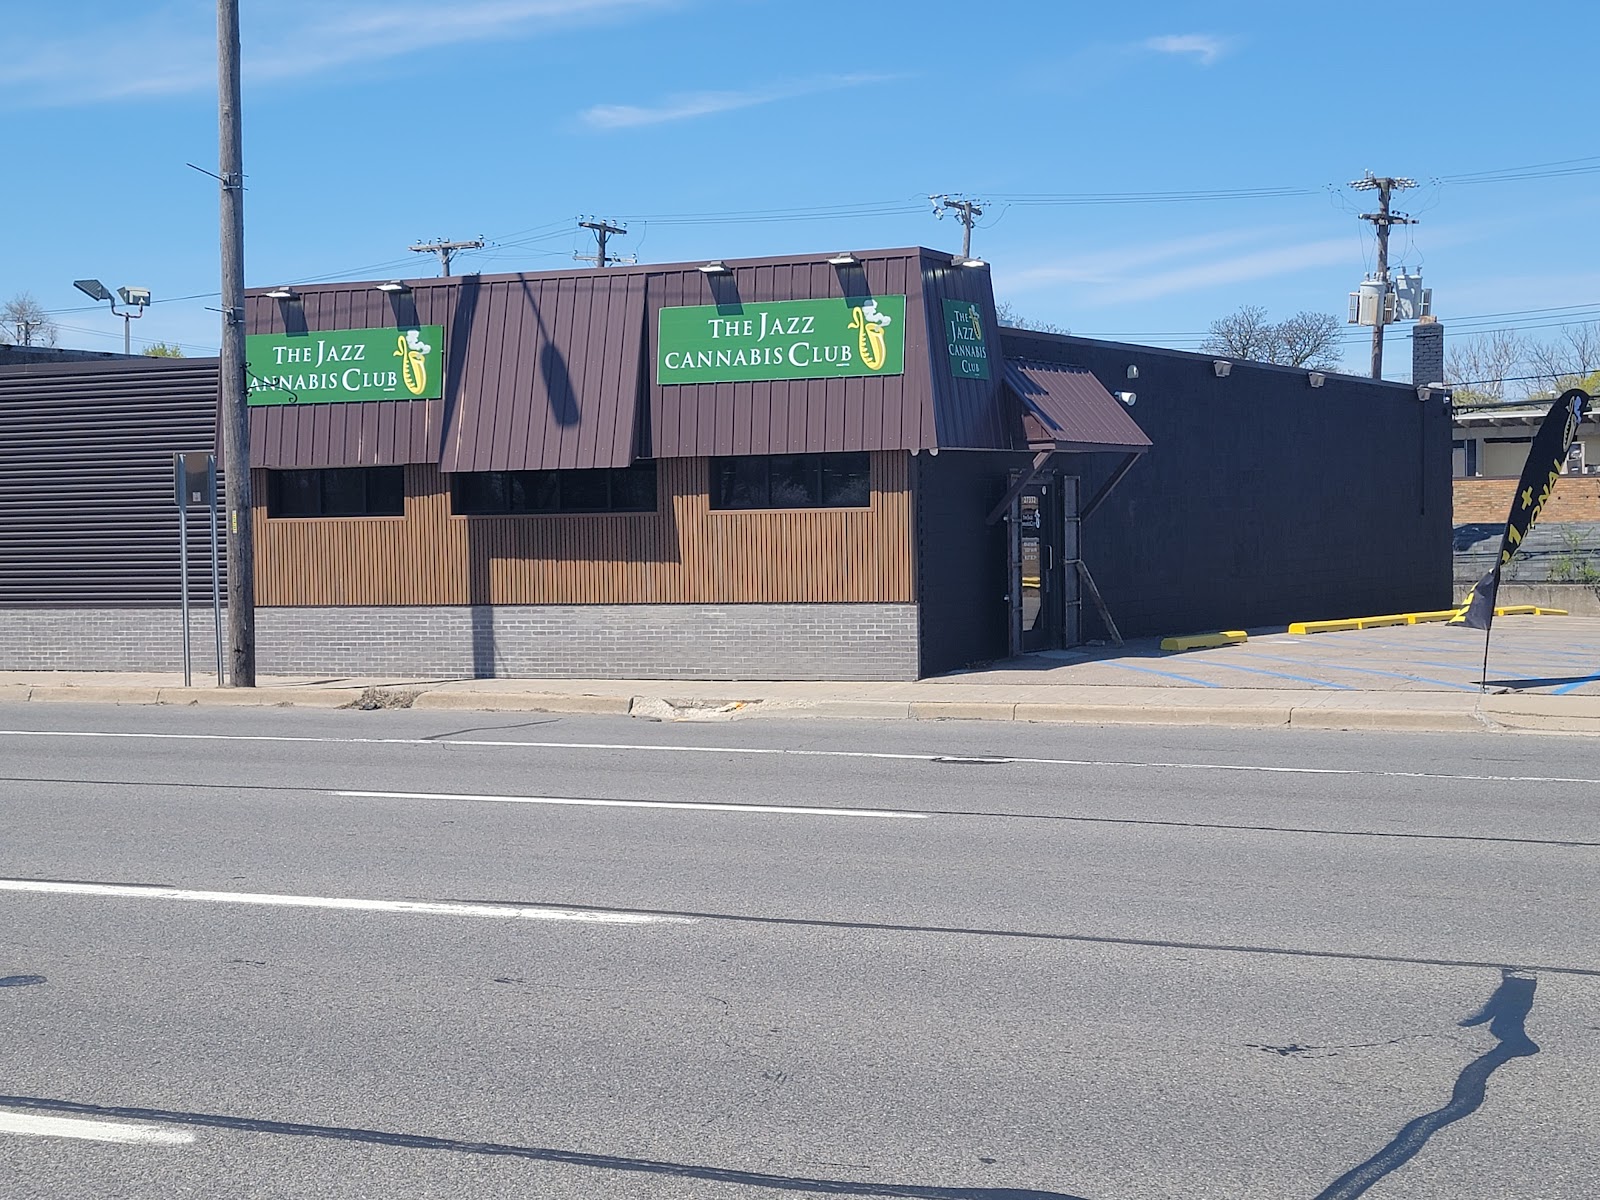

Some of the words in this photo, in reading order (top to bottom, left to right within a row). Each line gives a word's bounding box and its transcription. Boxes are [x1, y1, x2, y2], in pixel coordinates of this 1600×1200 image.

[707, 317, 753, 339] THE
[757, 312, 815, 342] JAZZ
[953, 310, 969, 323] THE
[950, 320, 975, 343] JAZZ
[272, 345, 312, 365] THE
[314, 340, 366, 368] JAZZ
[664, 347, 783, 369] CANNABIS
[788, 342, 852, 367] CLUB
[948, 343, 987, 359] CANNABIS
[961, 359, 980, 374] CLUB
[249, 372, 338, 392] ANNABIS
[341, 368, 398, 392] CLUB
